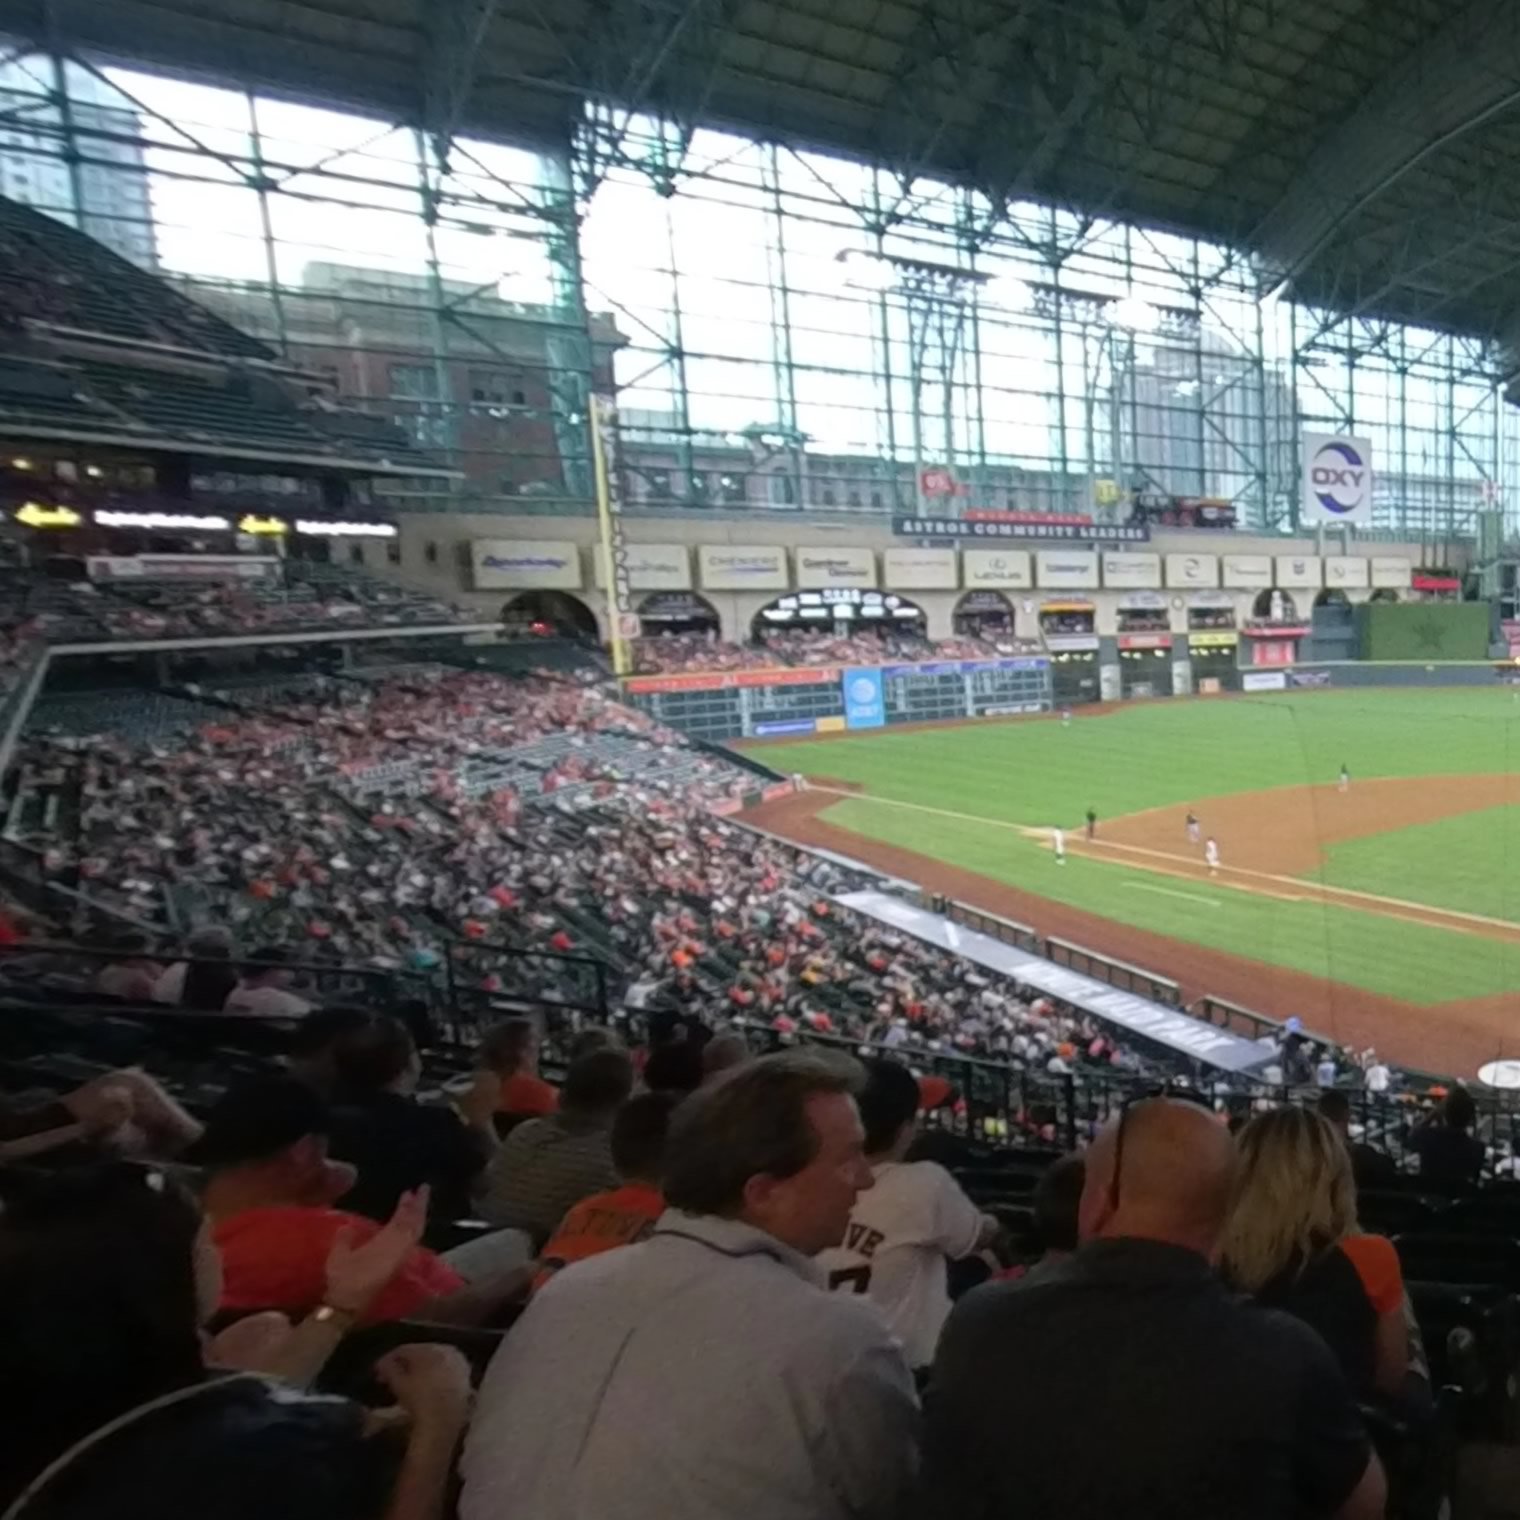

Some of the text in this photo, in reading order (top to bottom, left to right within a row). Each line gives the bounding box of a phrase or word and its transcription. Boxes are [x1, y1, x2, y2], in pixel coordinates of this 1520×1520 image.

[1311, 467, 1364, 488] OXY
[902, 519, 1144, 540] ASTROS COMMUNITY LEADERS
